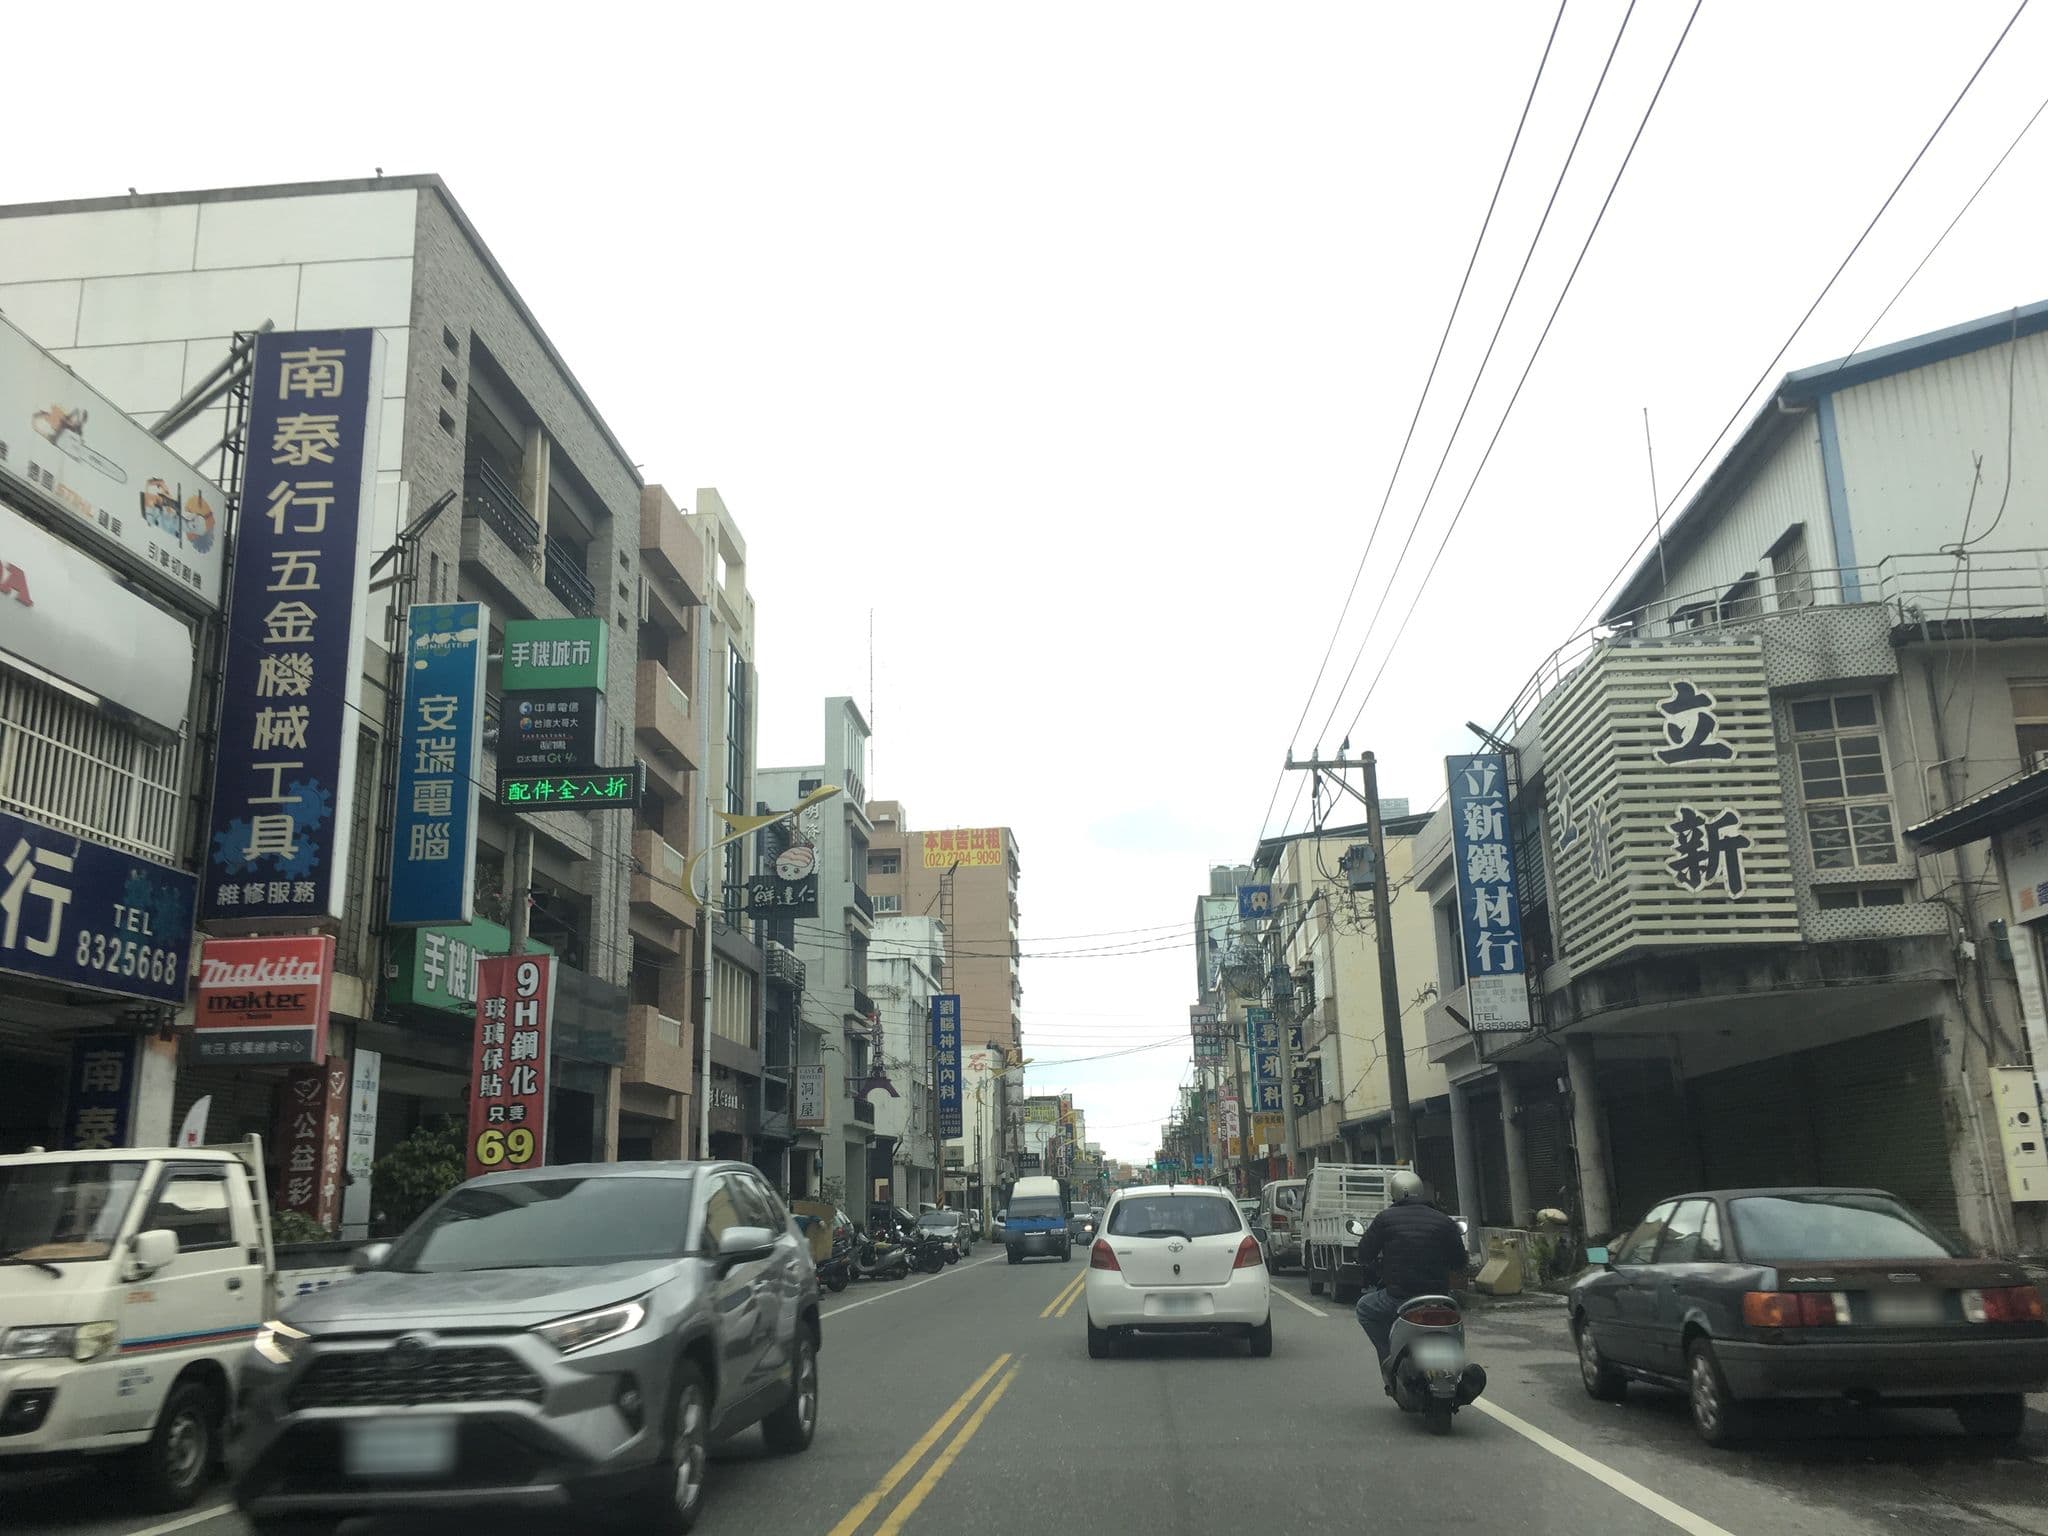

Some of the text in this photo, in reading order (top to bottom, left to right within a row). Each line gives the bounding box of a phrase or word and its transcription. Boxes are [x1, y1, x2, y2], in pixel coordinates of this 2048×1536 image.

[243, 347, 346, 861] 南泰行五金機械工具
[511, 640, 591, 668] 手機城市
[408, 694, 458, 862] 安瑞電腦
[507, 776, 628, 801] 配件全八折
[1653, 678, 1757, 899] 立新
[924, 829, 1000, 852] 本廣告出租
[1461, 759, 1518, 972] 立新鐵材行
[0, 838, 74, 957] 行
[112, 903, 153, 937] TEL
[217, 881, 316, 906] 維修服務
[75, 929, 178, 986] 8325668
[479, 997, 508, 1098] 玻璃保貼
[488, 1104, 527, 1122] 只要
[288, 1111, 318, 1206] 公益彩
[475, 1128, 535, 1166] 69
